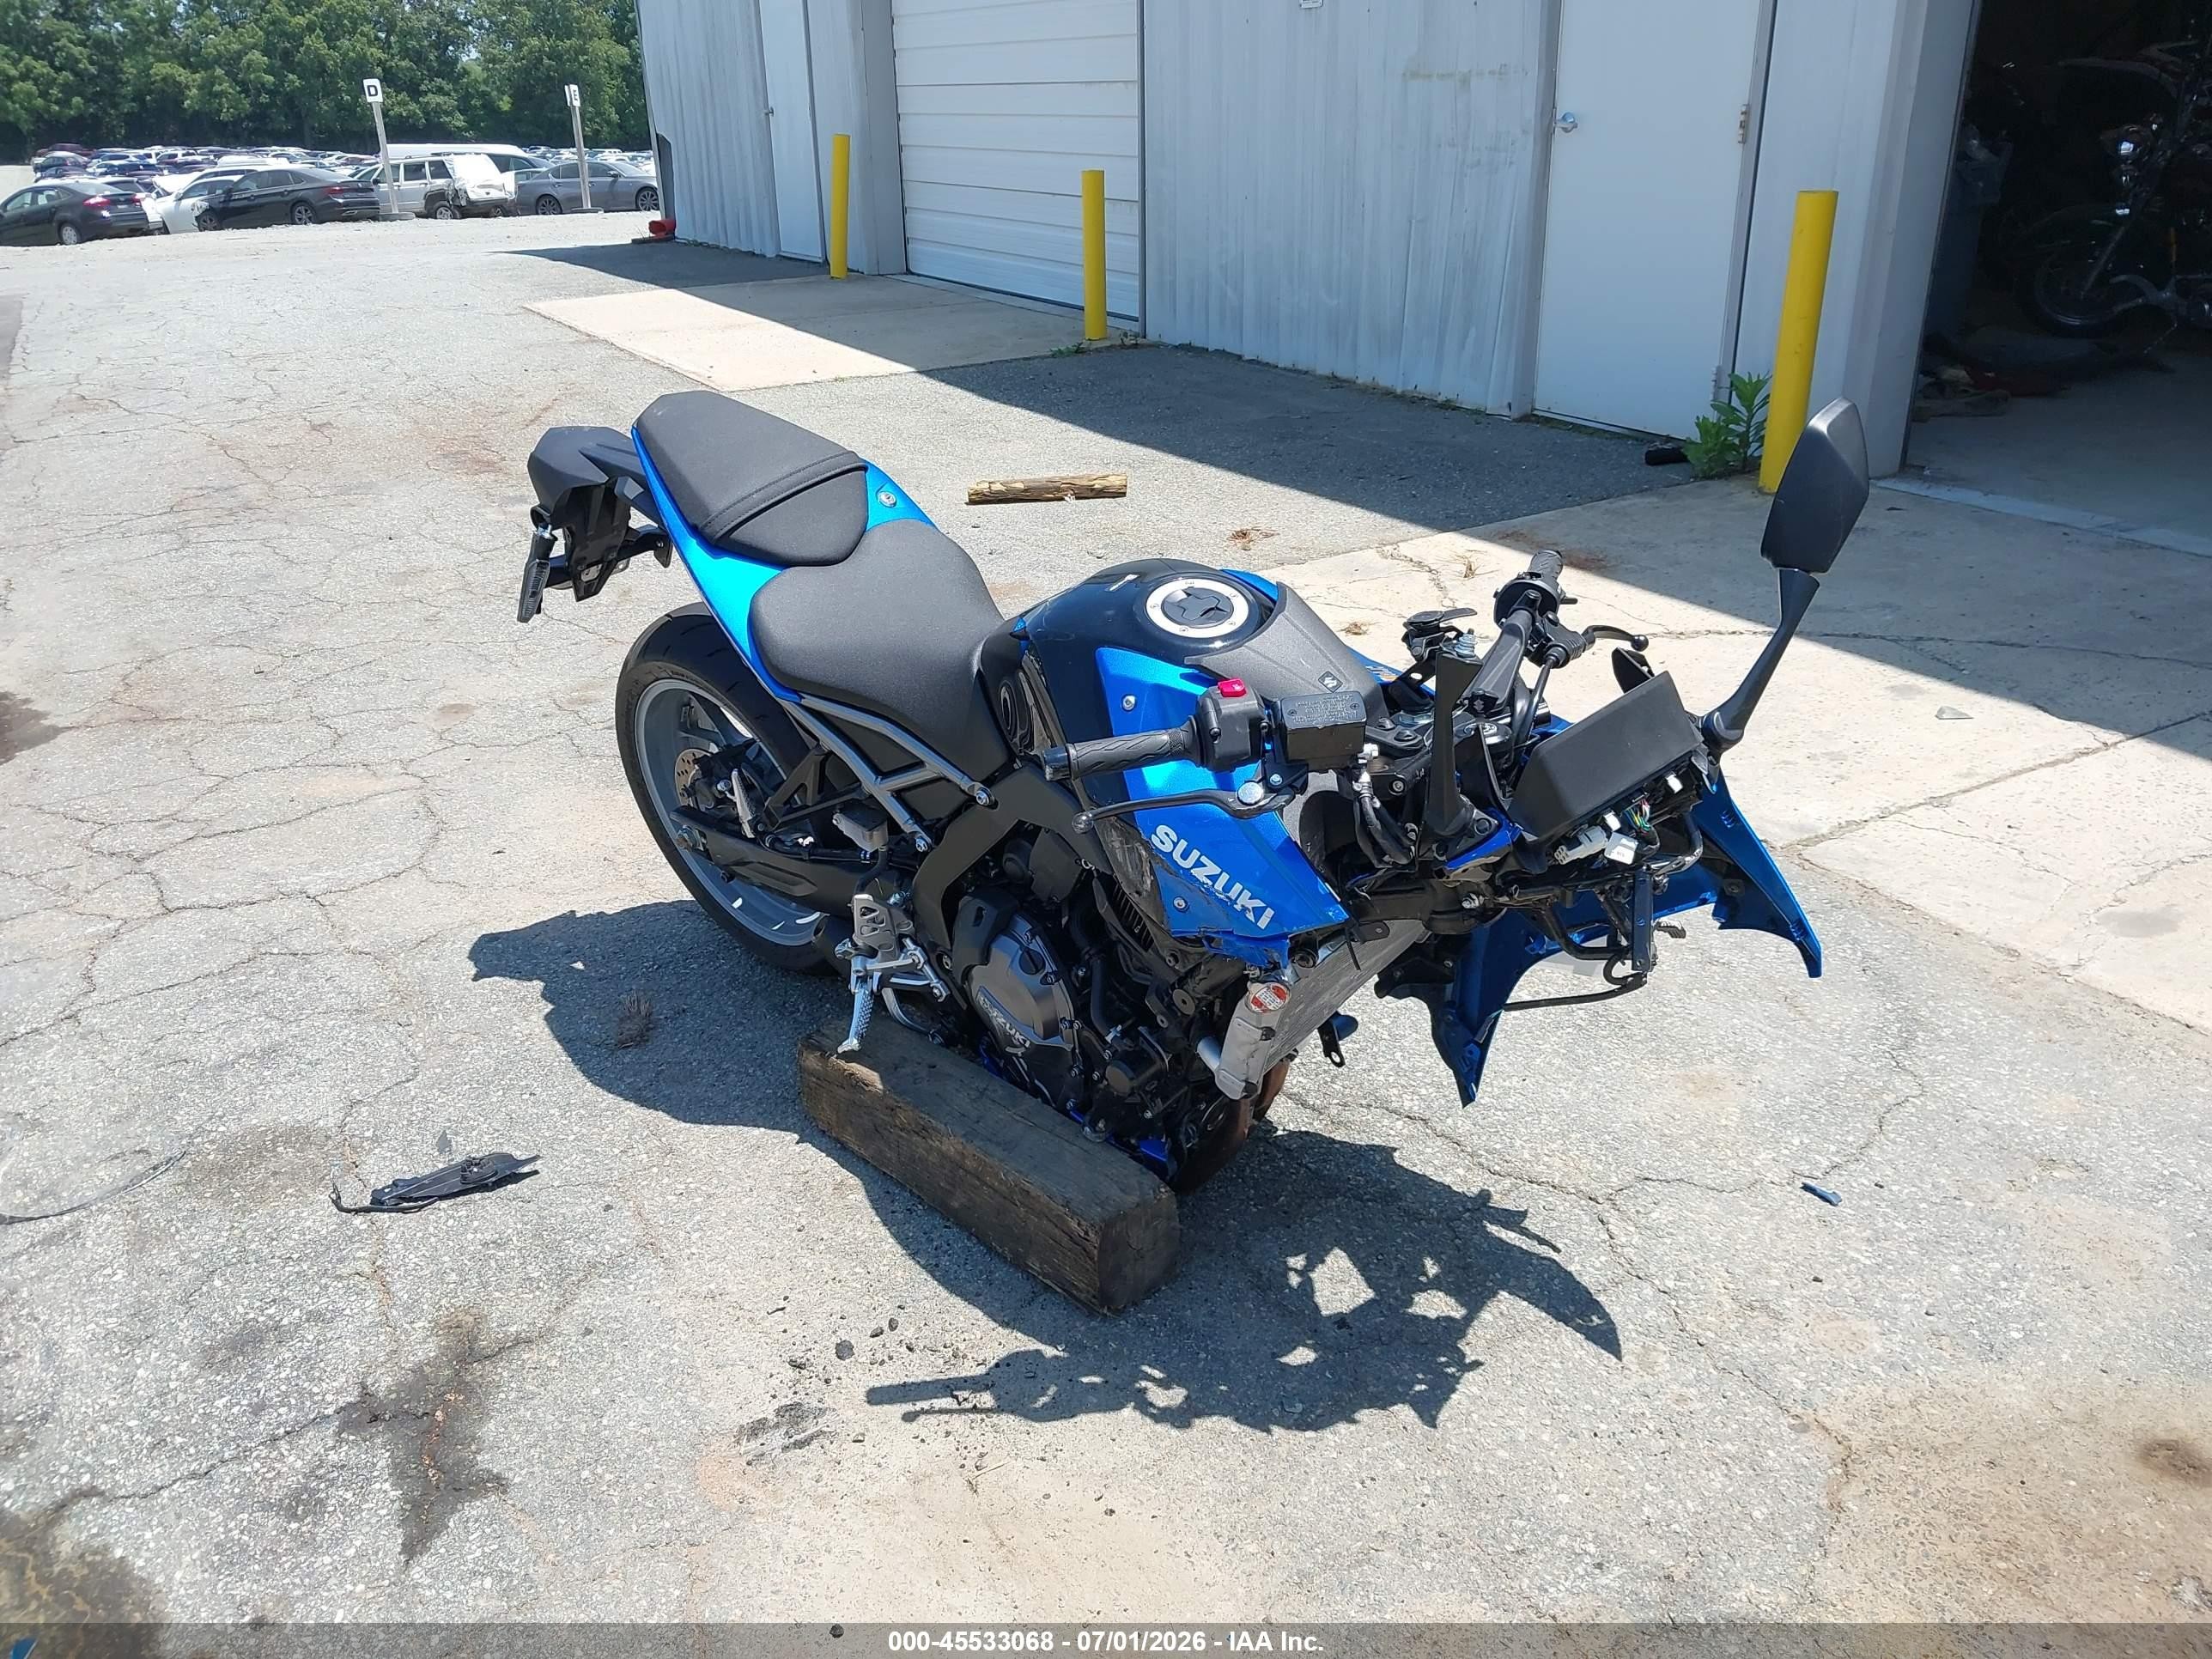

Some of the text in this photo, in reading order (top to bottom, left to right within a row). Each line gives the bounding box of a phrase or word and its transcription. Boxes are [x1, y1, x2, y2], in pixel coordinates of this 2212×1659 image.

[367, 85, 379, 97] D
[573, 89, 579, 101] E
[1151, 824, 1275, 930] SUZUKI
